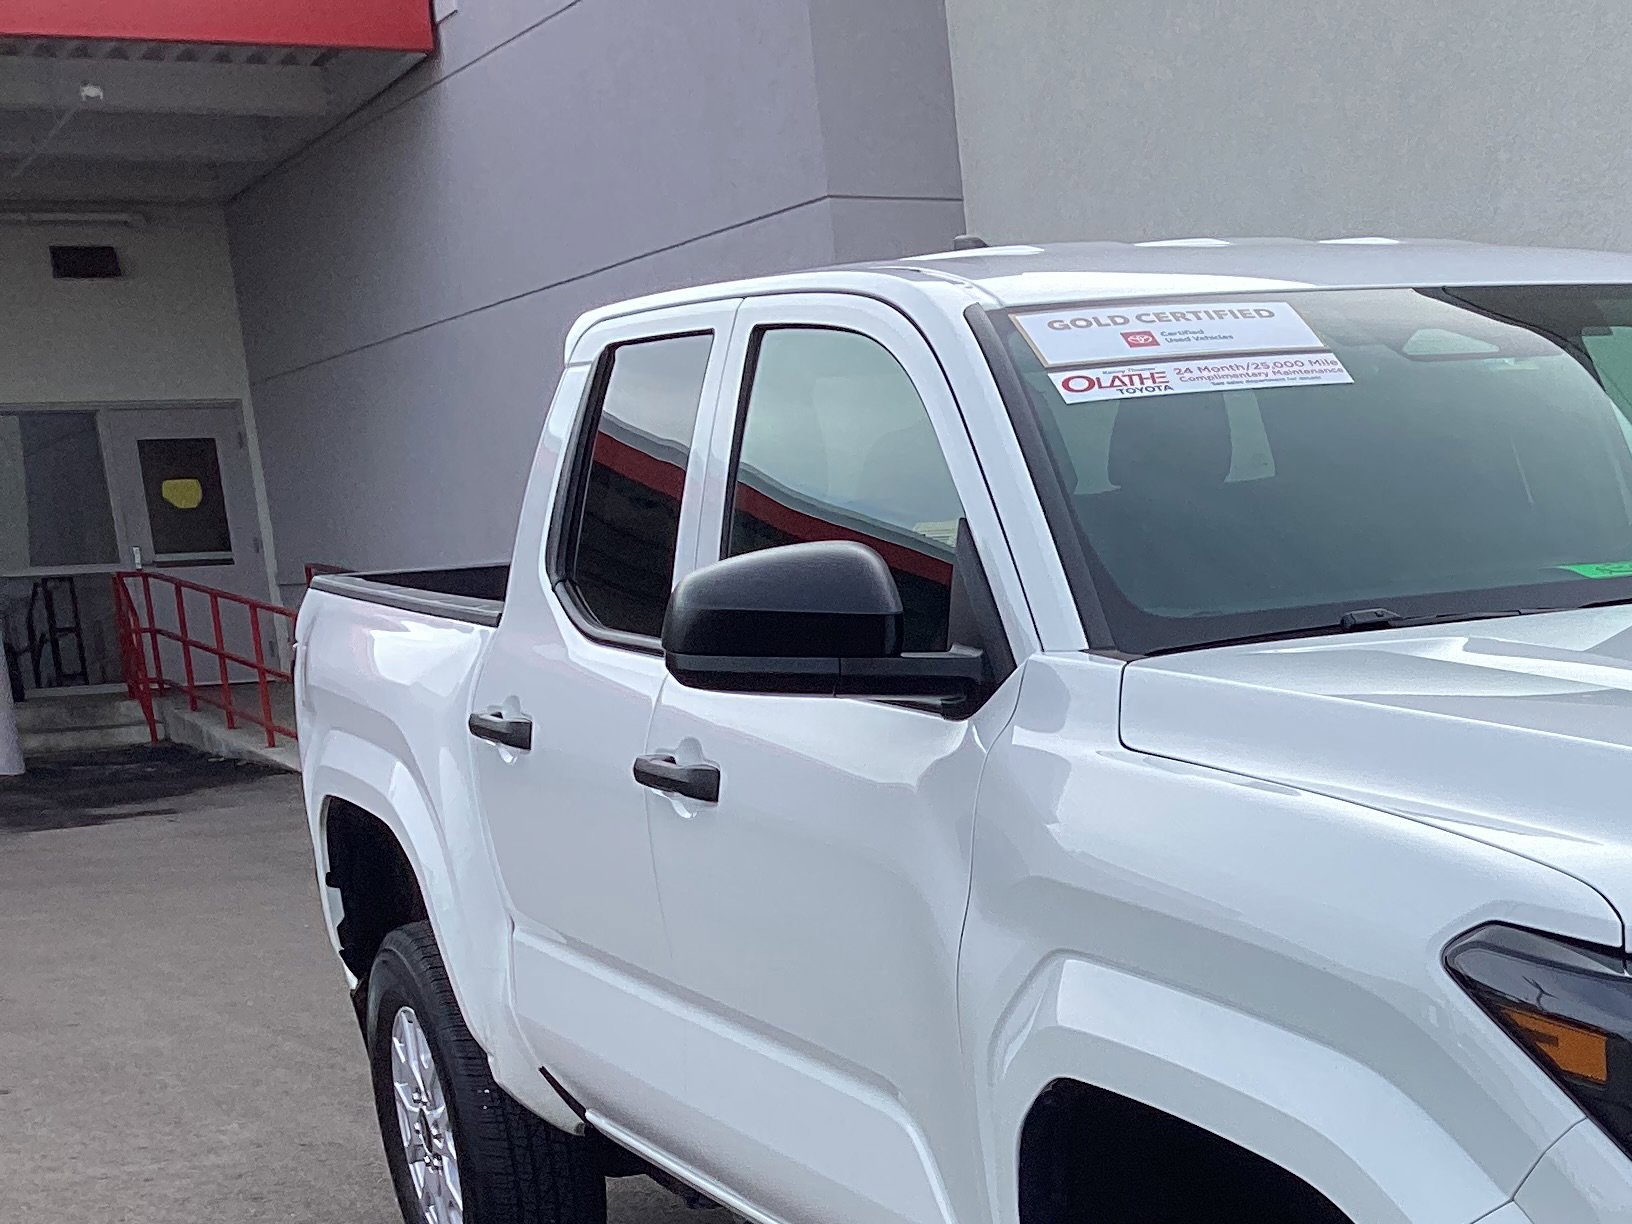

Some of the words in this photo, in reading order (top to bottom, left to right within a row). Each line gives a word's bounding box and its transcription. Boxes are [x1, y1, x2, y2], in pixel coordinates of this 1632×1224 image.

[1047, 314, 1130, 331] GOLD
[1135, 308, 1275, 323] CERTIFIED
[1160, 329, 1205, 338] Certified
[1165, 336, 1191, 344] Used
[1193, 334, 1234, 342] Vehicles
[1174, 367, 1193, 376] 24
[1197, 359, 1305, 373] Month/25,000
[1308, 358, 1339, 367] Mile
[1179, 370, 1269, 383] Complimentary
[1271, 367, 1344, 376] Maintenance
[1061, 371, 1170, 393] OLATHE
[1116, 384, 1174, 395] TOYOTA
